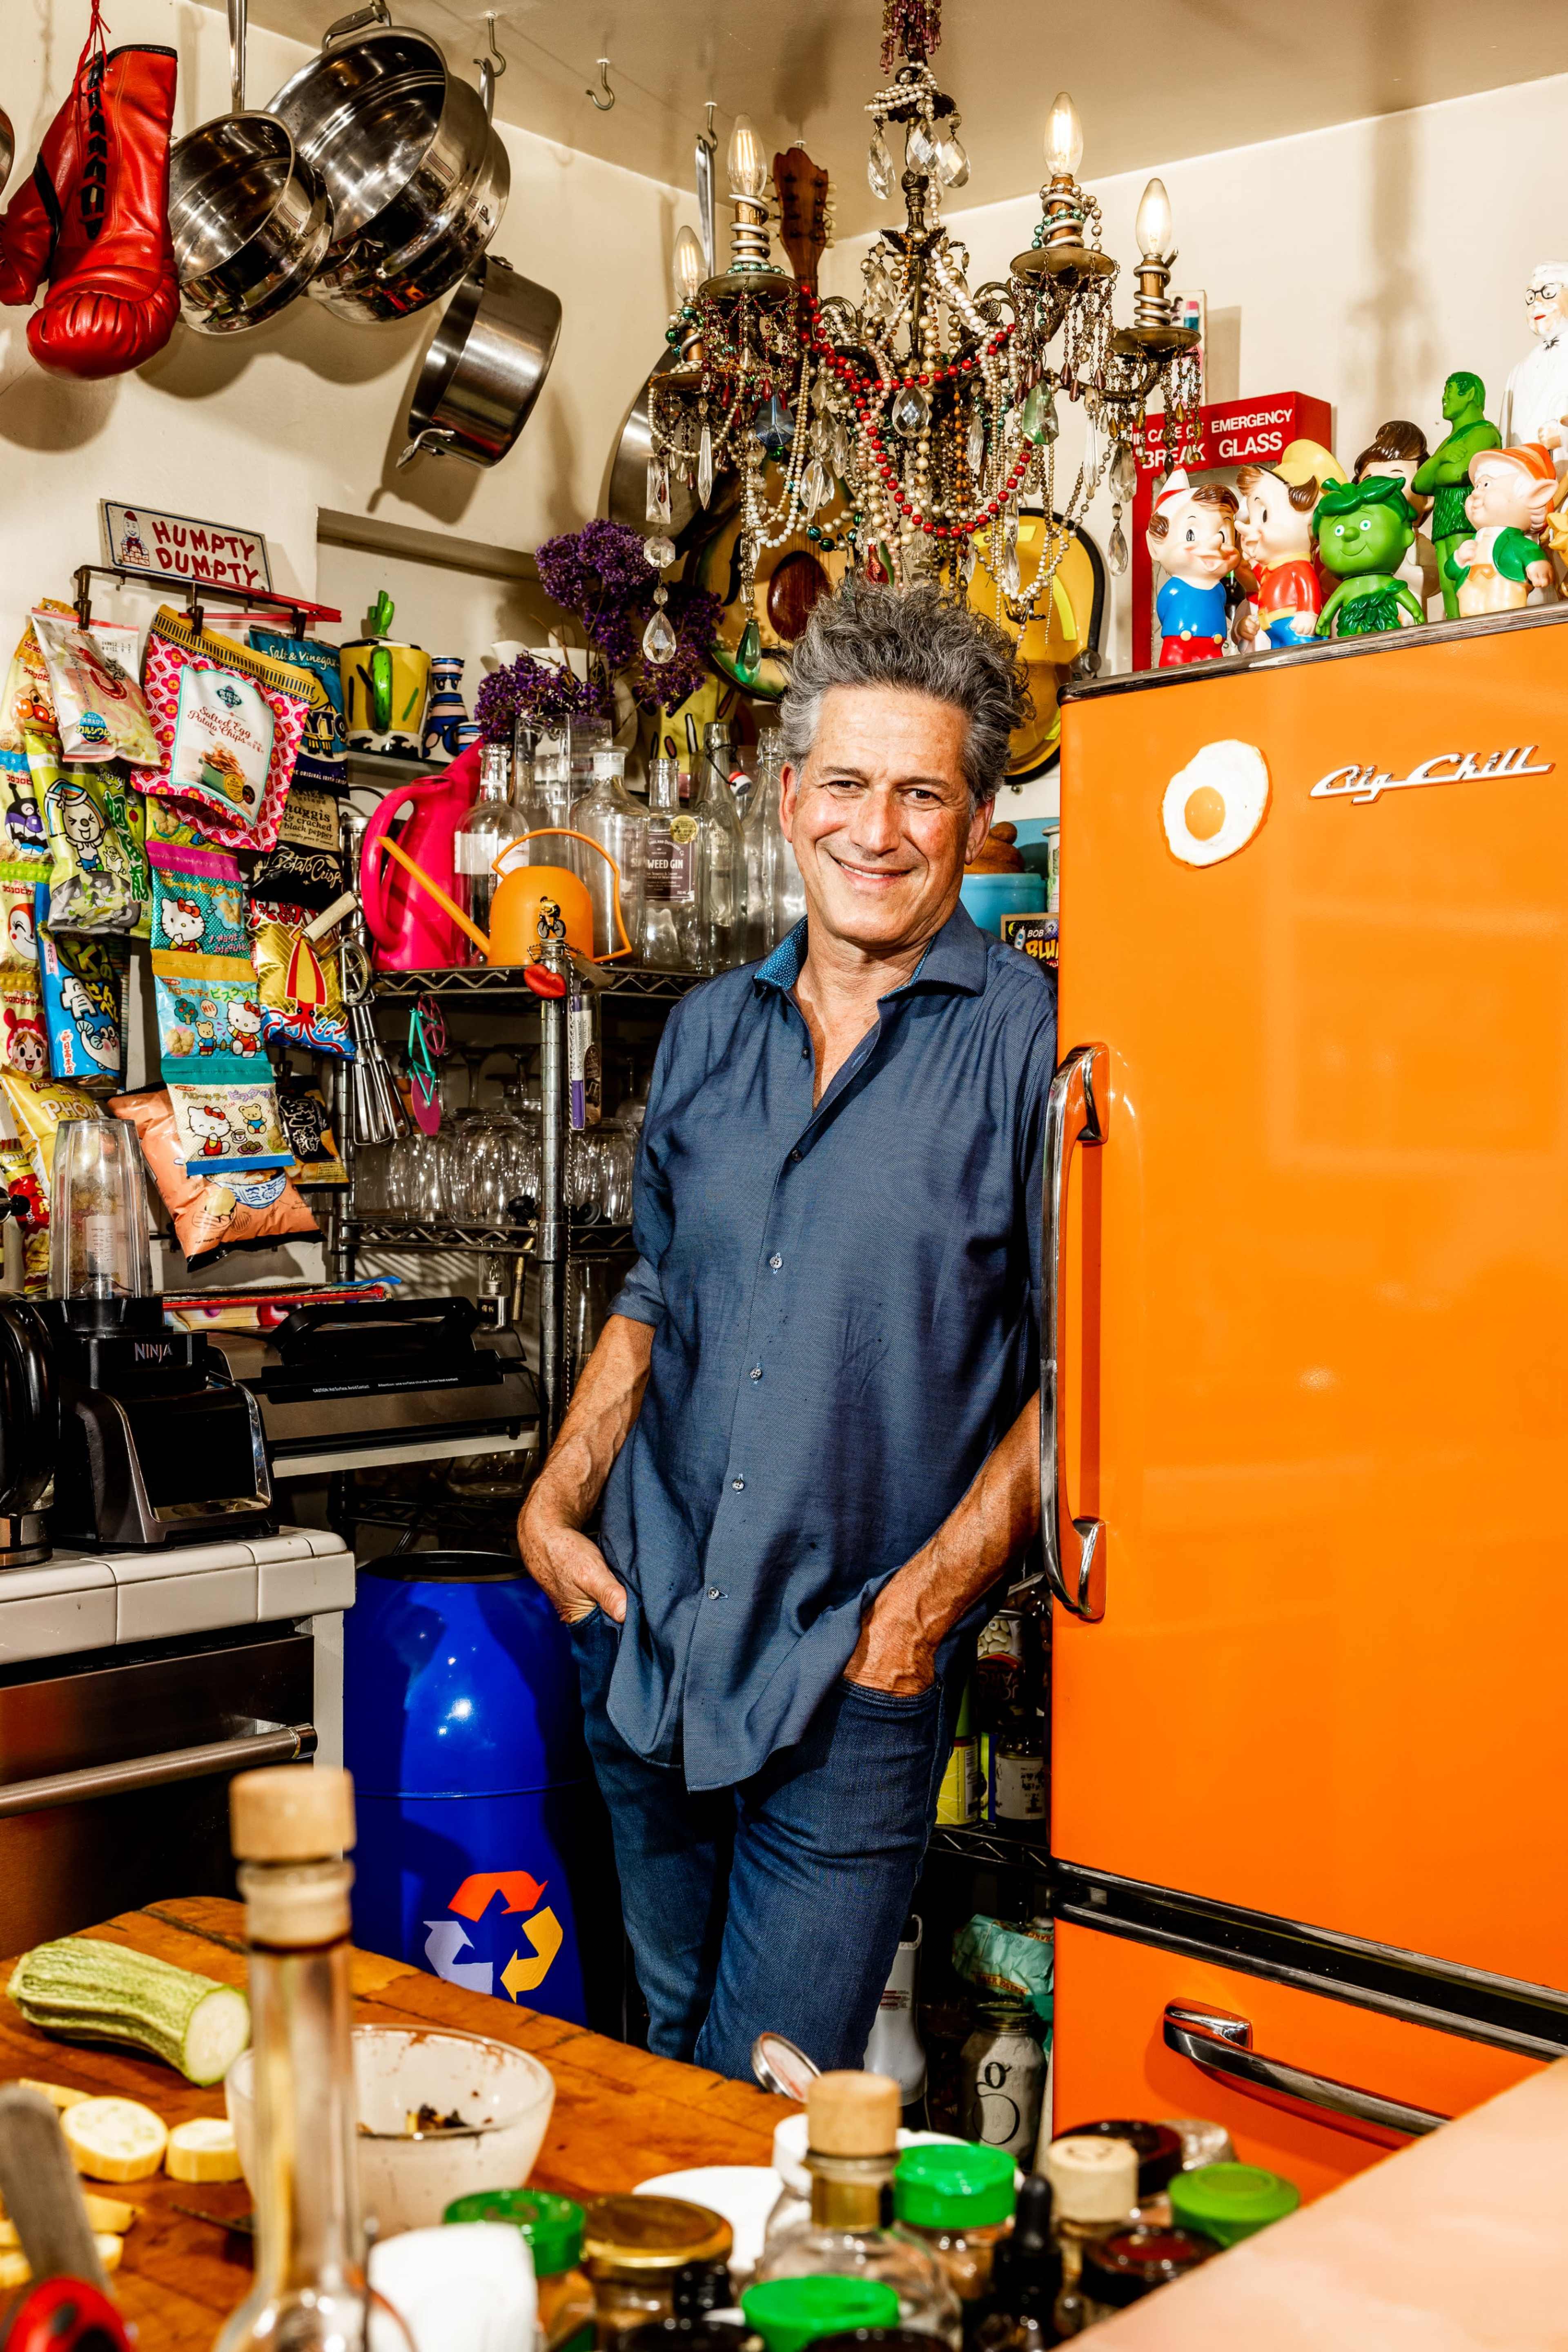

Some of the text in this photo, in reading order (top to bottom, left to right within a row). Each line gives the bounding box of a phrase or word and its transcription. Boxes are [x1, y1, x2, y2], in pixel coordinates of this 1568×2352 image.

[1148, 426, 1182, 443] CAE
[1211, 408, 1293, 433] EMERGENCY
[1218, 432, 1283, 459] GLASS
[152, 521, 255, 562] HUMPTY
[155, 547, 258, 586] DUMPTY
[269, 645, 336, 670] Salt & Vinegar
[76, 725, 111, 737] カルシウム
[188, 710, 246, 743] Potato Chips
[200, 706, 251, 739] Salted Egg
[300, 771, 322, 780] ORIGINAL
[1308, 745, 1557, 806] Big Chill
[285, 803, 331, 823] haggis
[284, 822, 333, 840] black pepper
[296, 817, 332, 832] cracked
[271, 850, 312, 875] Potato
[670, 859, 683, 869] GIN
[199, 882, 242, 898] ビスケット
[217, 934, 239, 943] want
[1027, 929, 1044, 938] BOB
[1025, 939, 1059, 959] BLU
[168, 986, 209, 998] ハローキティ
[209, 987, 258, 1001] ビスケット
[63, 1042, 76, 1075] 日高本店
[182, 1092, 228, 1101] ハローキティ
[134, 1342, 173, 1363] NINJA
[972, 2062, 1020, 2145] g
